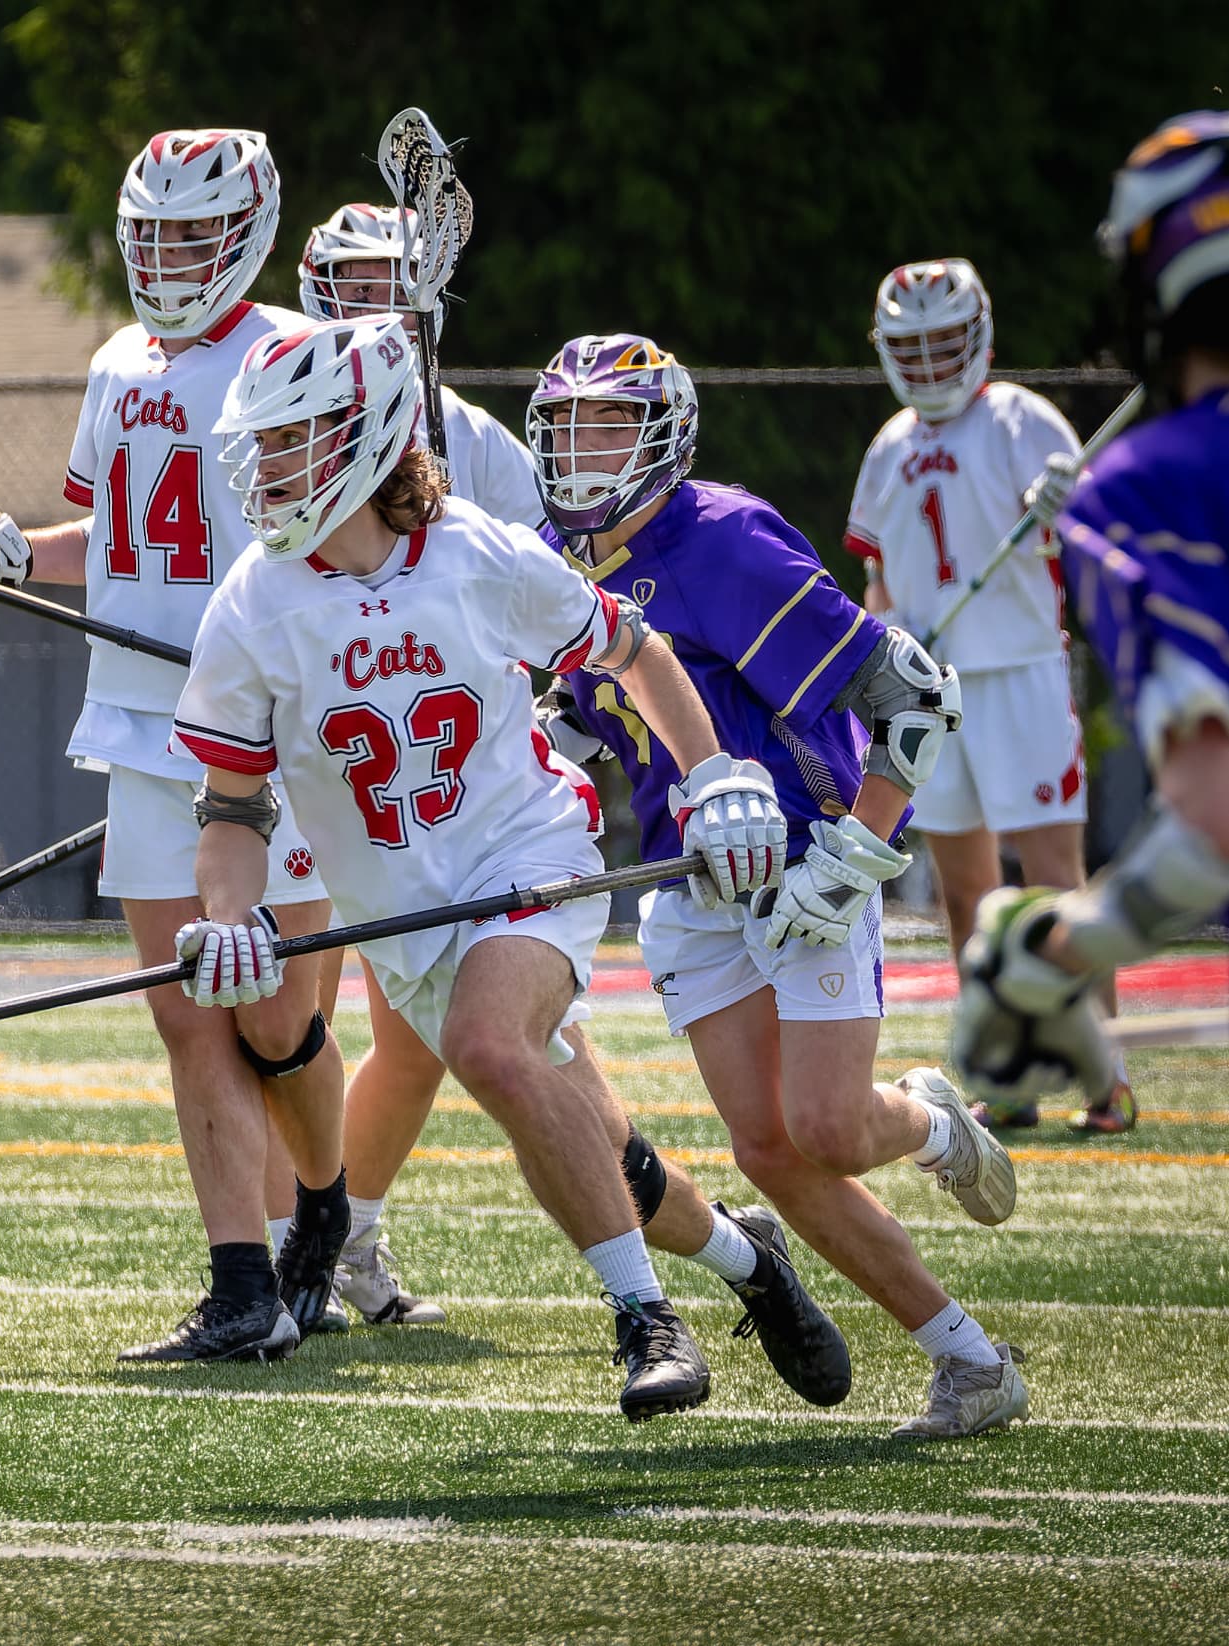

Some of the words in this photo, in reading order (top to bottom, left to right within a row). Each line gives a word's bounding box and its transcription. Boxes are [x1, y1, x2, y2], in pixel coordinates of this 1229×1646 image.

[377, 336, 404, 370] 23
[113, 386, 188, 435] 'Cats
[105, 442, 214, 585] 14
[919, 487, 958, 588] 1
[331, 631, 445, 691] 'Cats
[318, 683, 483, 850] 23
